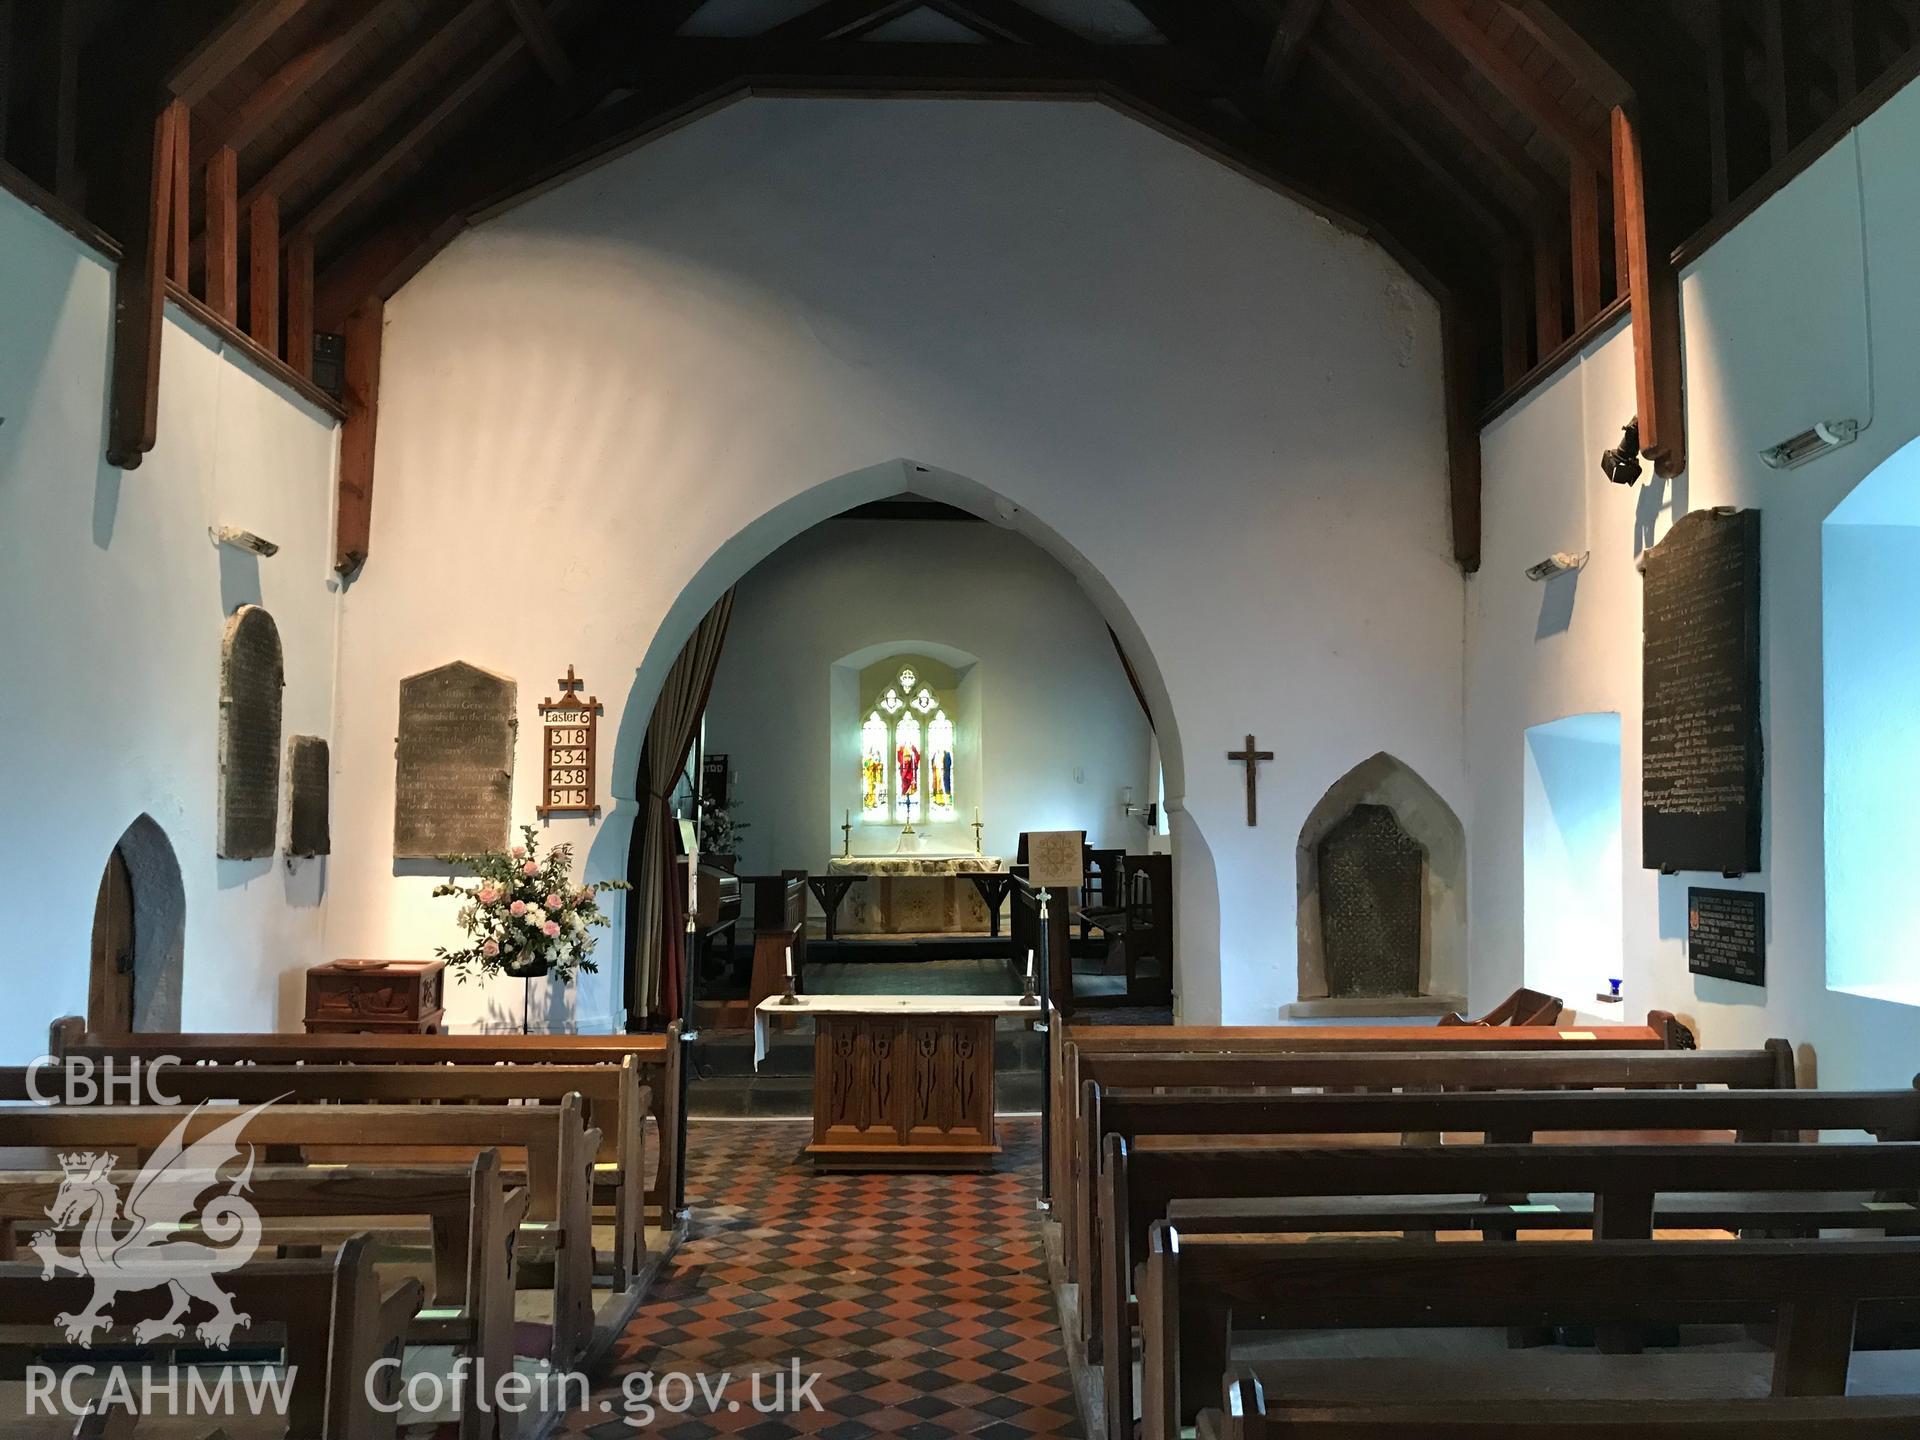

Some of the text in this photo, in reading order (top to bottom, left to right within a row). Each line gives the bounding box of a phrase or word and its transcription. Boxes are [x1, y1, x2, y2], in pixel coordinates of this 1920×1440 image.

[545, 710, 589, 723] Easter 6
[553, 730, 584, 744] 318
[553, 750, 585, 764] 534
[553, 770, 584, 784] 438
[553, 790, 584, 804] 515
